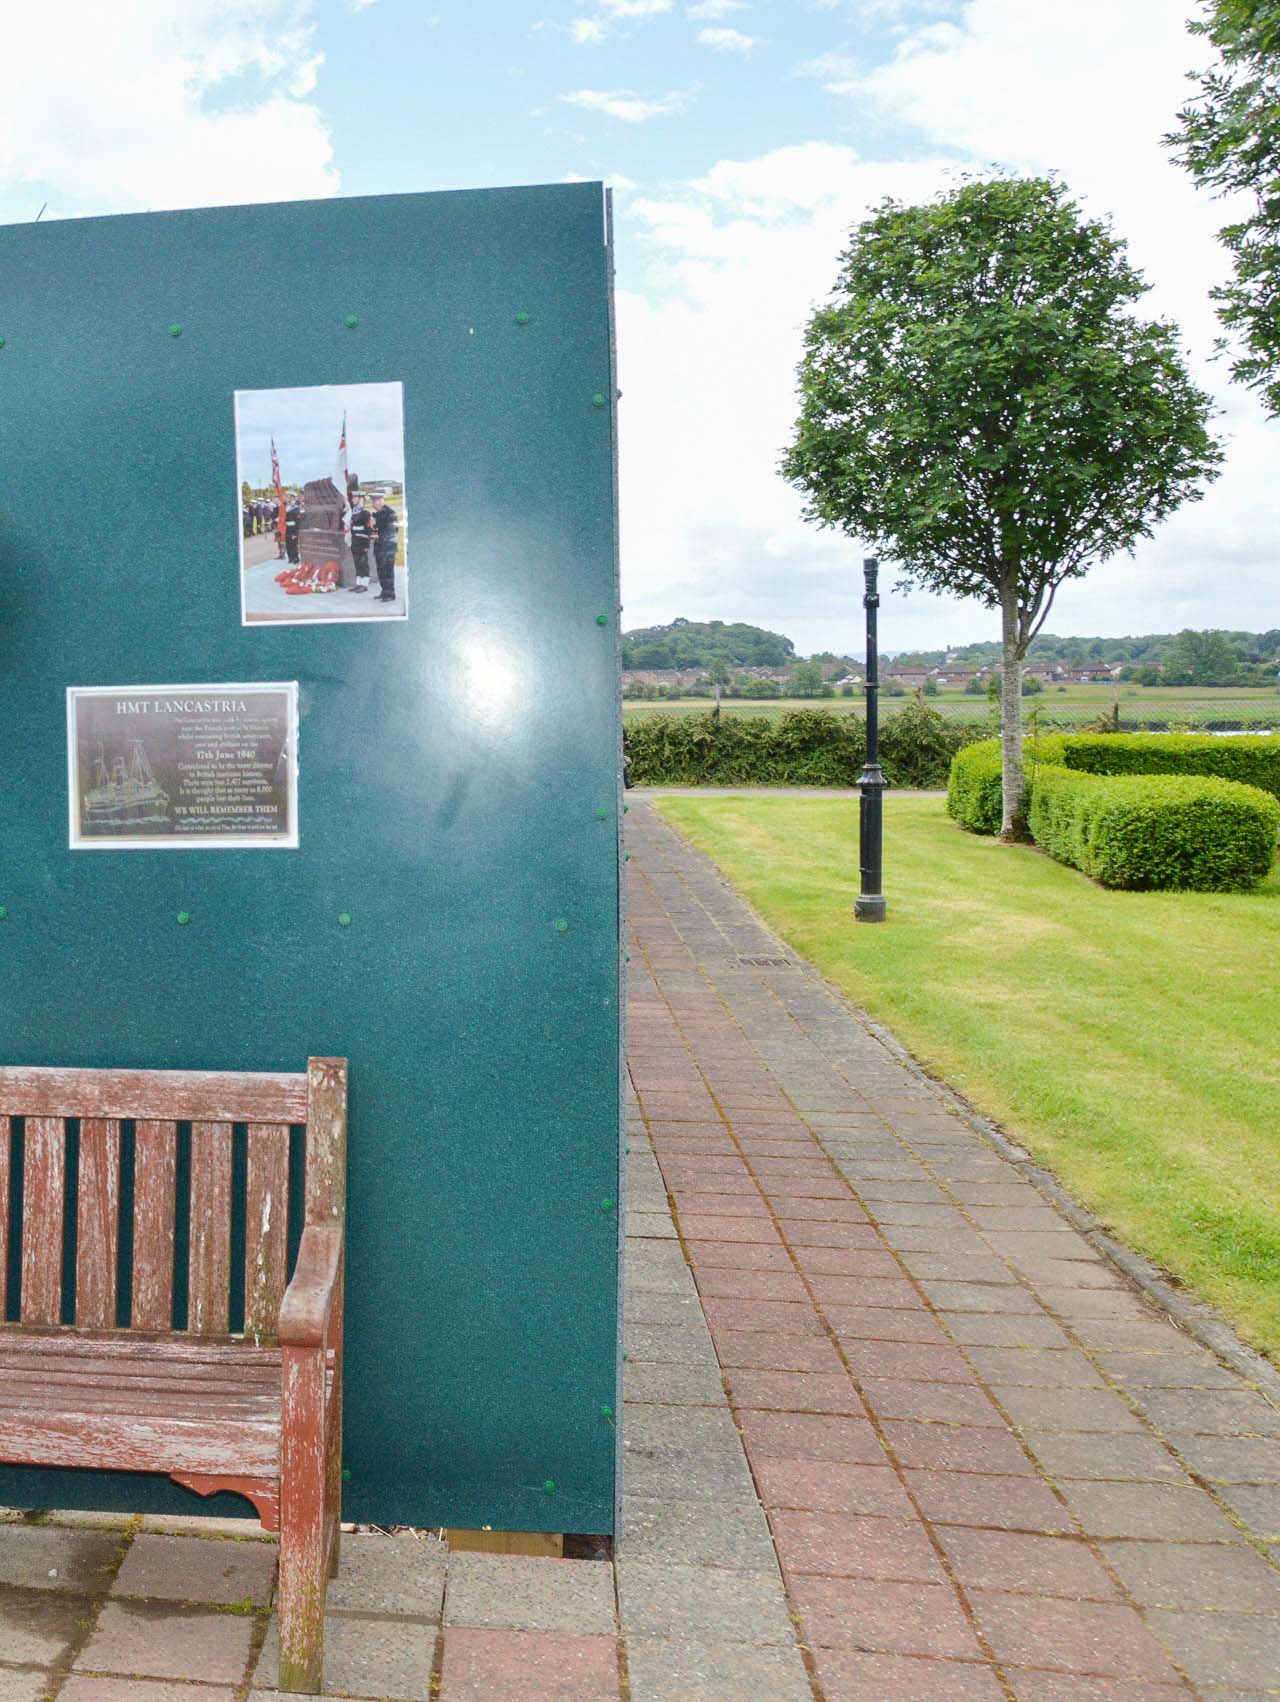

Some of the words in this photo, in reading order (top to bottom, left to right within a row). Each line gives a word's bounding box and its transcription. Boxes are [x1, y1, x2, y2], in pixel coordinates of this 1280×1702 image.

[116, 701, 151, 714] HMT
[155, 700, 247, 713] LANCASTRIA
[196, 751, 214, 759] 17th
[215, 750, 234, 760] June
[237, 750, 256, 759] 1940
[174, 806, 187, 814] WE
[188, 806, 209, 814] WILL
[210, 805, 253, 814] REMEMBER
[255, 805, 278, 813] THEM
